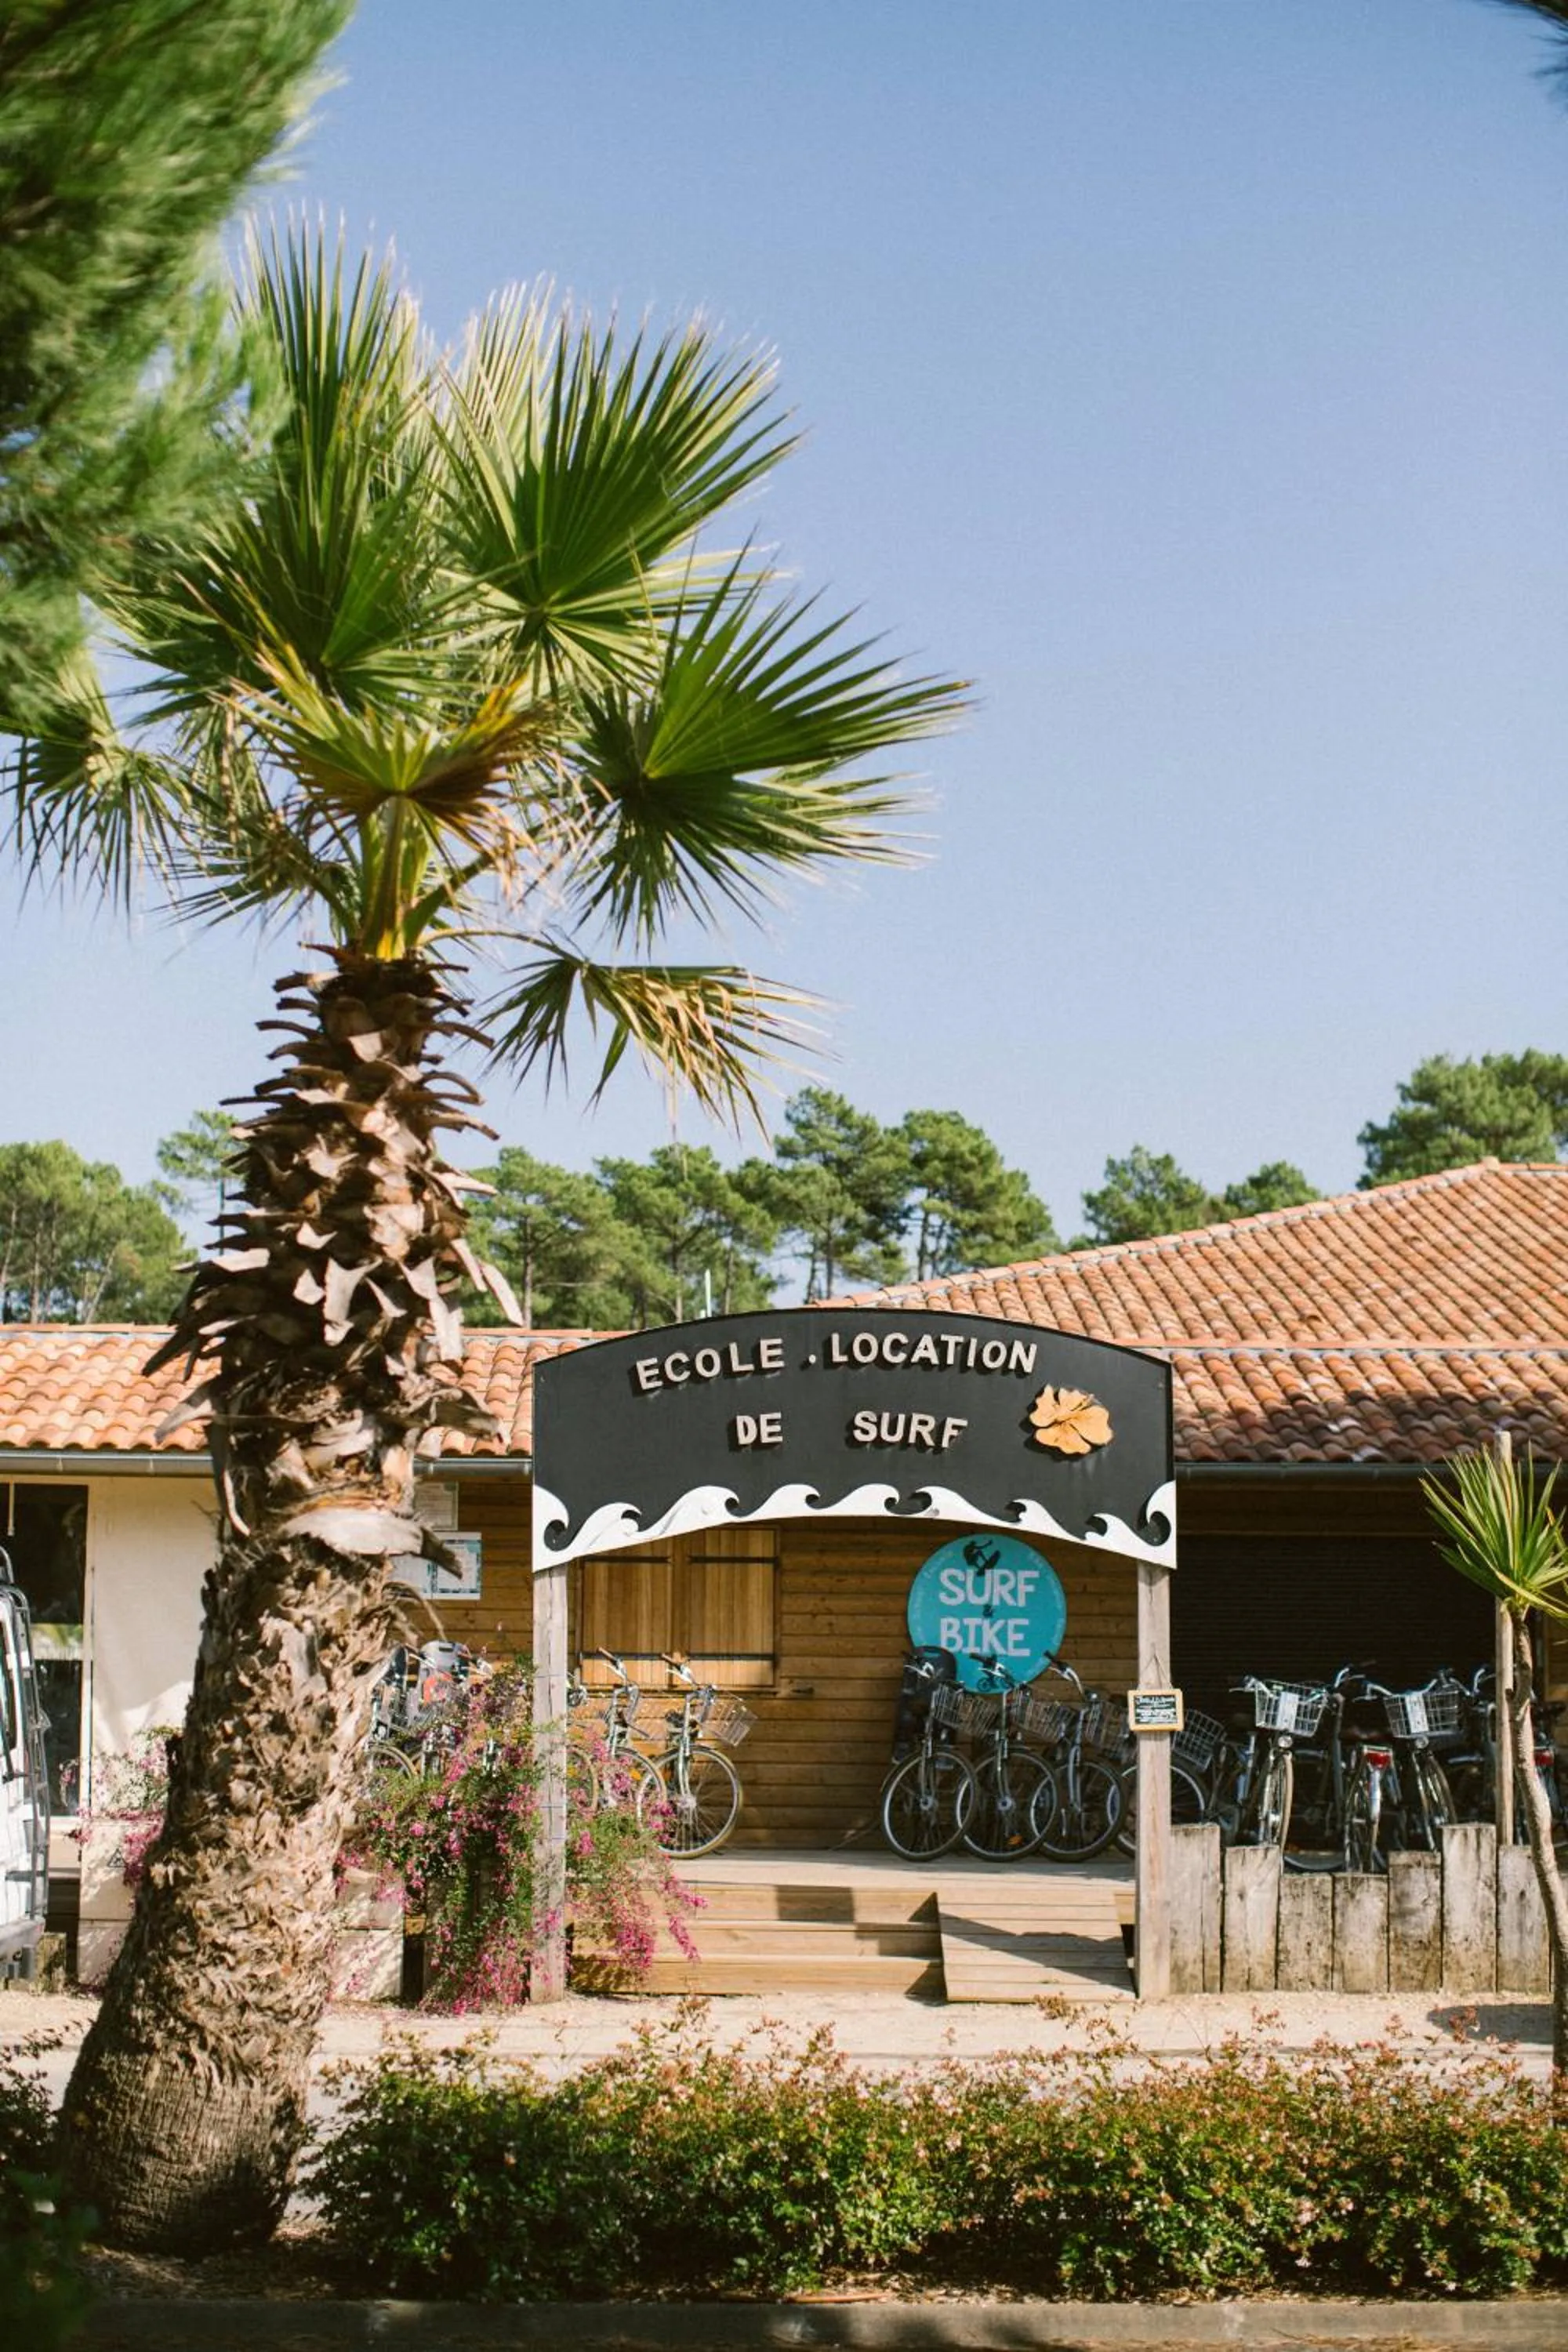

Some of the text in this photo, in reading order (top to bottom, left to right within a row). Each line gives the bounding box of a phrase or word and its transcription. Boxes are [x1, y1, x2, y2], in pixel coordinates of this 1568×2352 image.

[636, 1338, 784, 1390] ECOLE
[831, 1332, 1037, 1373] LOCATION
[735, 1410, 968, 1448] DE SURF
[939, 1568, 1040, 1607] SURF
[940, 1617, 1032, 1657] BIKE
